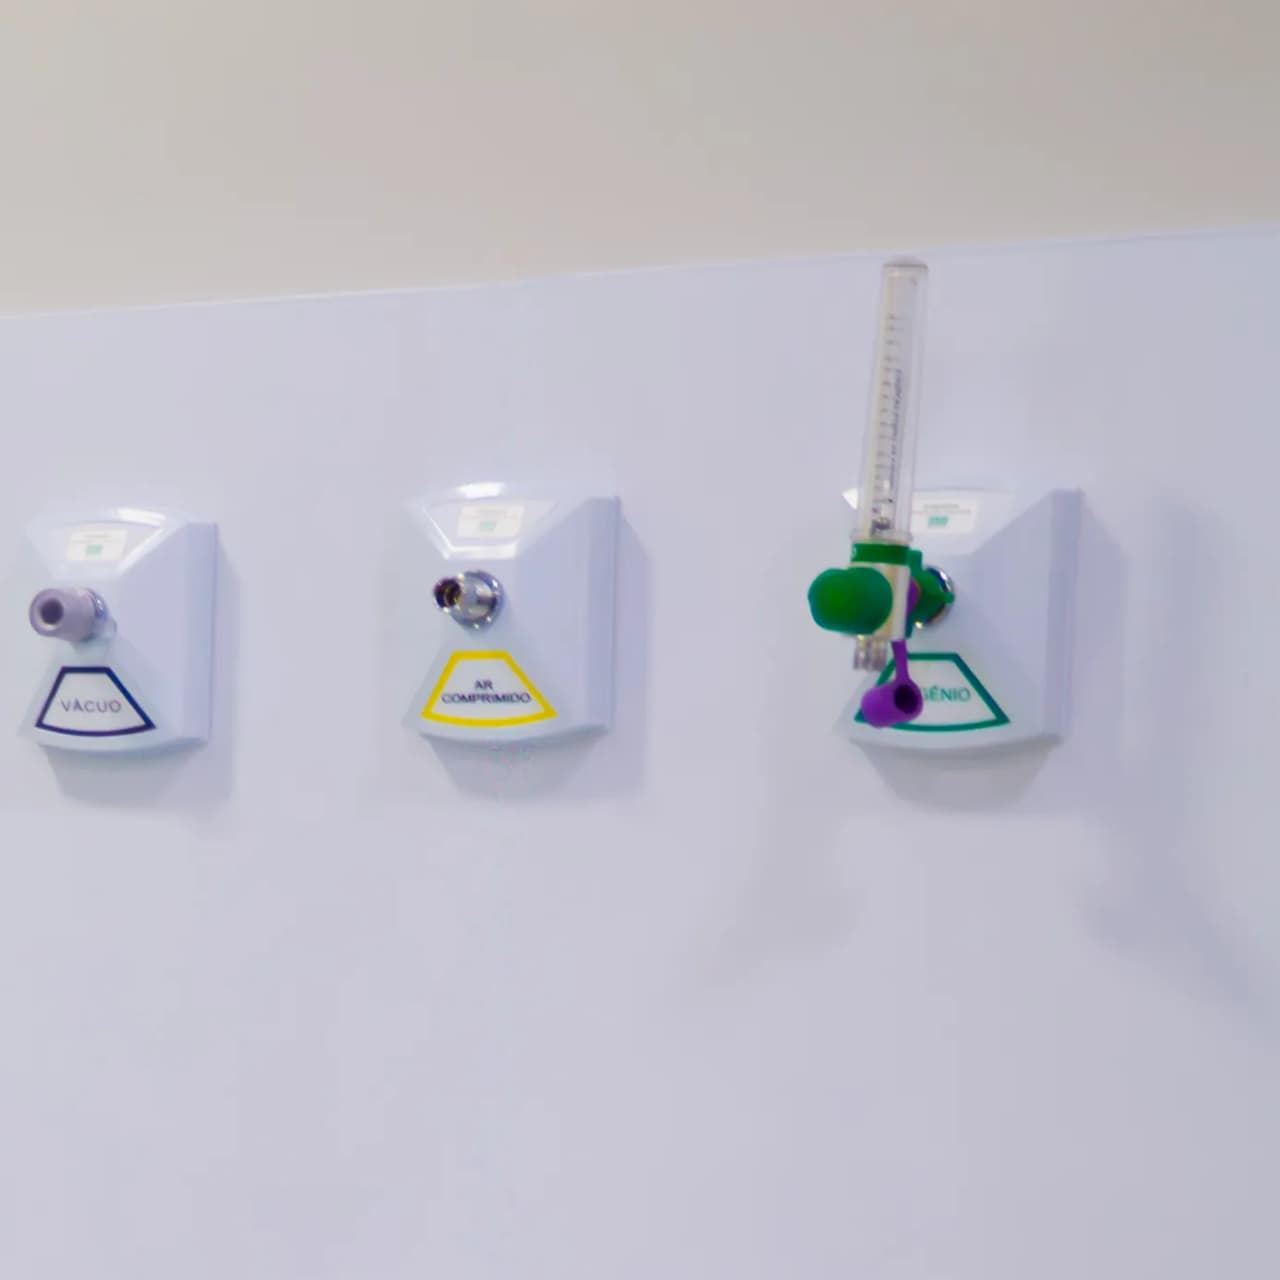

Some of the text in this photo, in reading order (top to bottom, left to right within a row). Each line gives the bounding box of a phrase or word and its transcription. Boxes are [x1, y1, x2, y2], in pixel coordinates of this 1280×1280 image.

[474, 679, 494, 691] AR
[441, 691, 531, 704] COMPRIMIDO
[922, 684, 971, 702] ÊNIO
